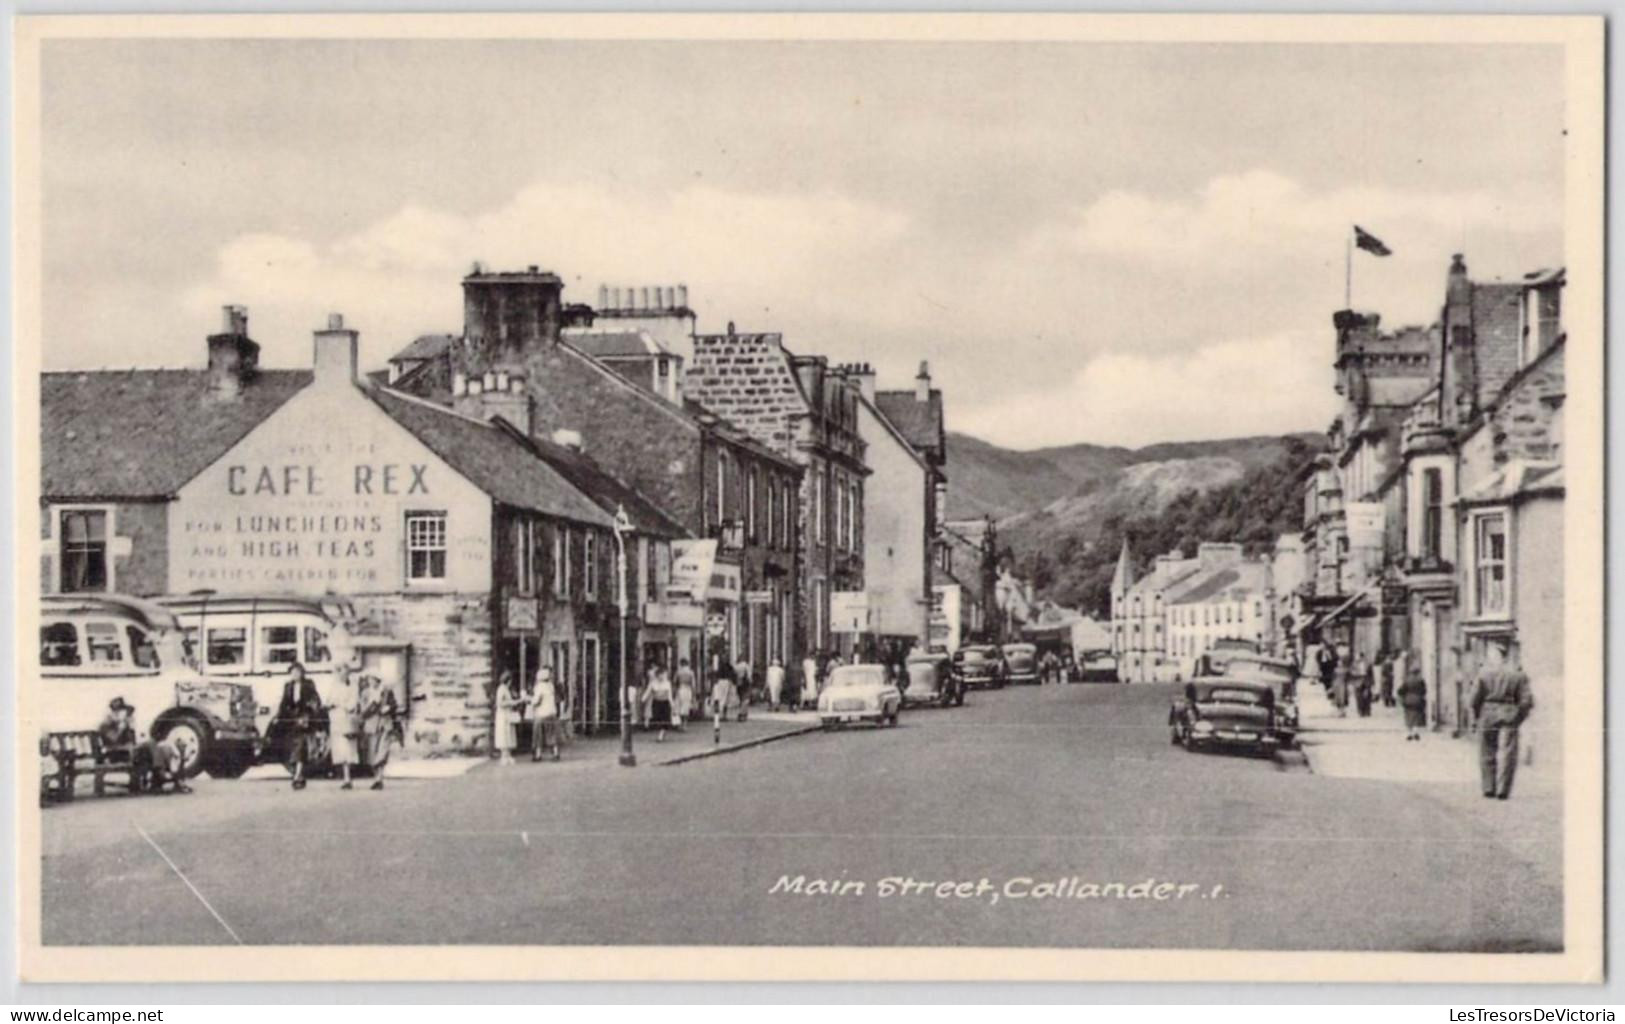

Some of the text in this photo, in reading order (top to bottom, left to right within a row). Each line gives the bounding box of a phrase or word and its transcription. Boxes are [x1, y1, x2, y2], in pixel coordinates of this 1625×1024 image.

[227, 464, 431, 497] CAFE REX
[185, 516, 382, 534] FOR LUNCHEONS
[241, 541, 299, 558] HIGH
[316, 540, 376, 558] TEAS
[768, 870, 866, 897] Main
